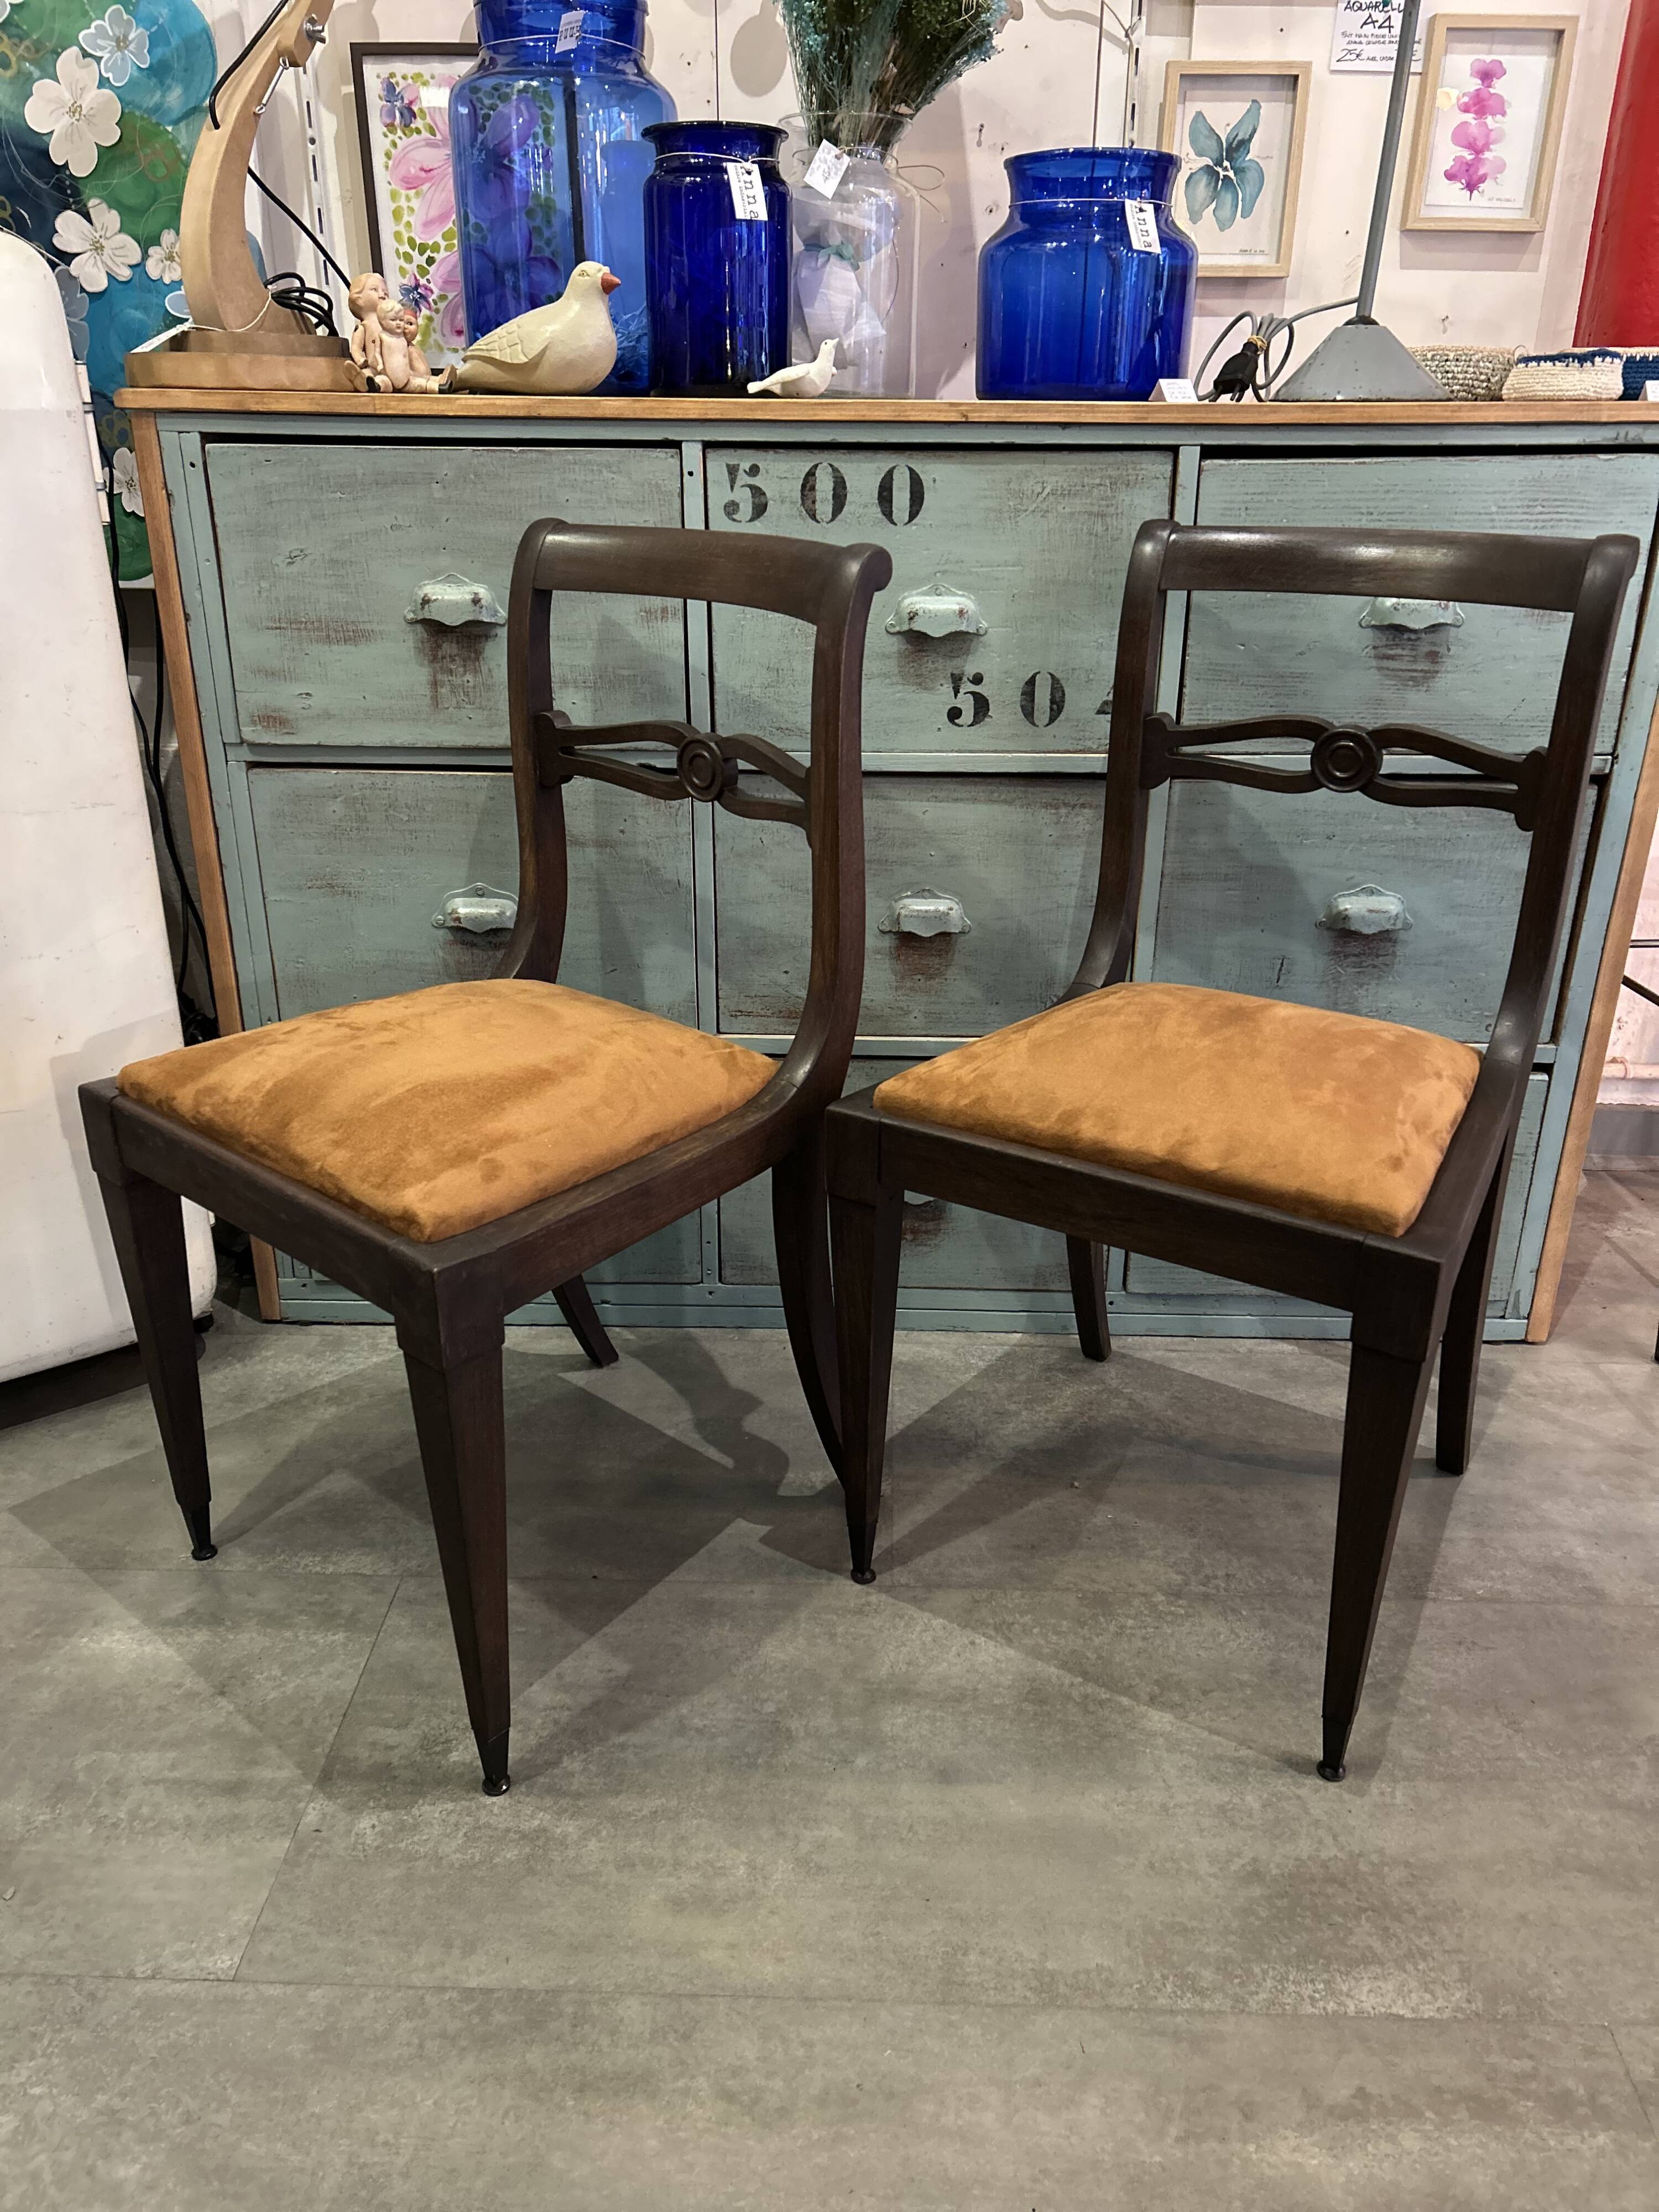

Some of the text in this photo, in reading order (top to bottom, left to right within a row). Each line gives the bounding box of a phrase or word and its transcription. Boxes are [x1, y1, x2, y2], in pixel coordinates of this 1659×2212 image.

[1360, 12, 1394, 33] A4
[1336, 49, 1365, 62] 25€
[1134, 204, 1152, 248] Anna
[723, 462, 925, 526] 500
